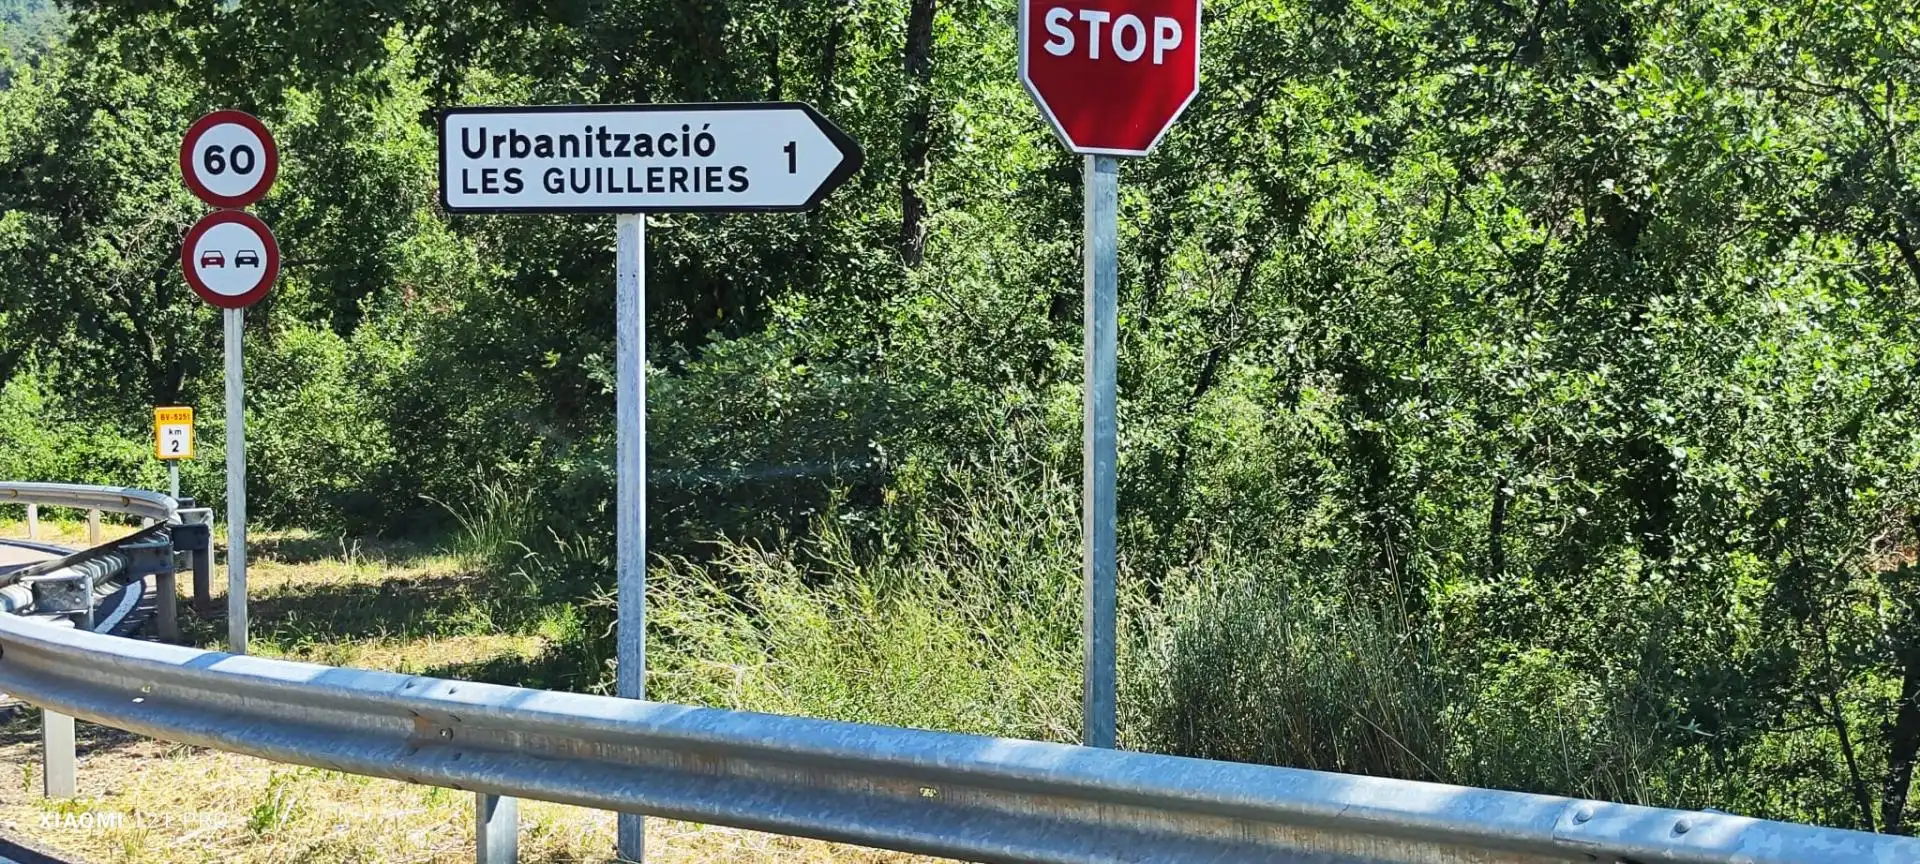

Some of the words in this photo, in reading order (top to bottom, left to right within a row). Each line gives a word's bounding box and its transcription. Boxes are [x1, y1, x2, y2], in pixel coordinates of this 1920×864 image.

[1043, 7, 1182, 65] STOP
[461, 124, 716, 159] Urbanització
[783, 141, 797, 174] 1
[204, 144, 255, 175] 60
[462, 168, 525, 195] LES
[543, 166, 750, 194] GUILLERIES
[171, 440, 179, 452] 2
